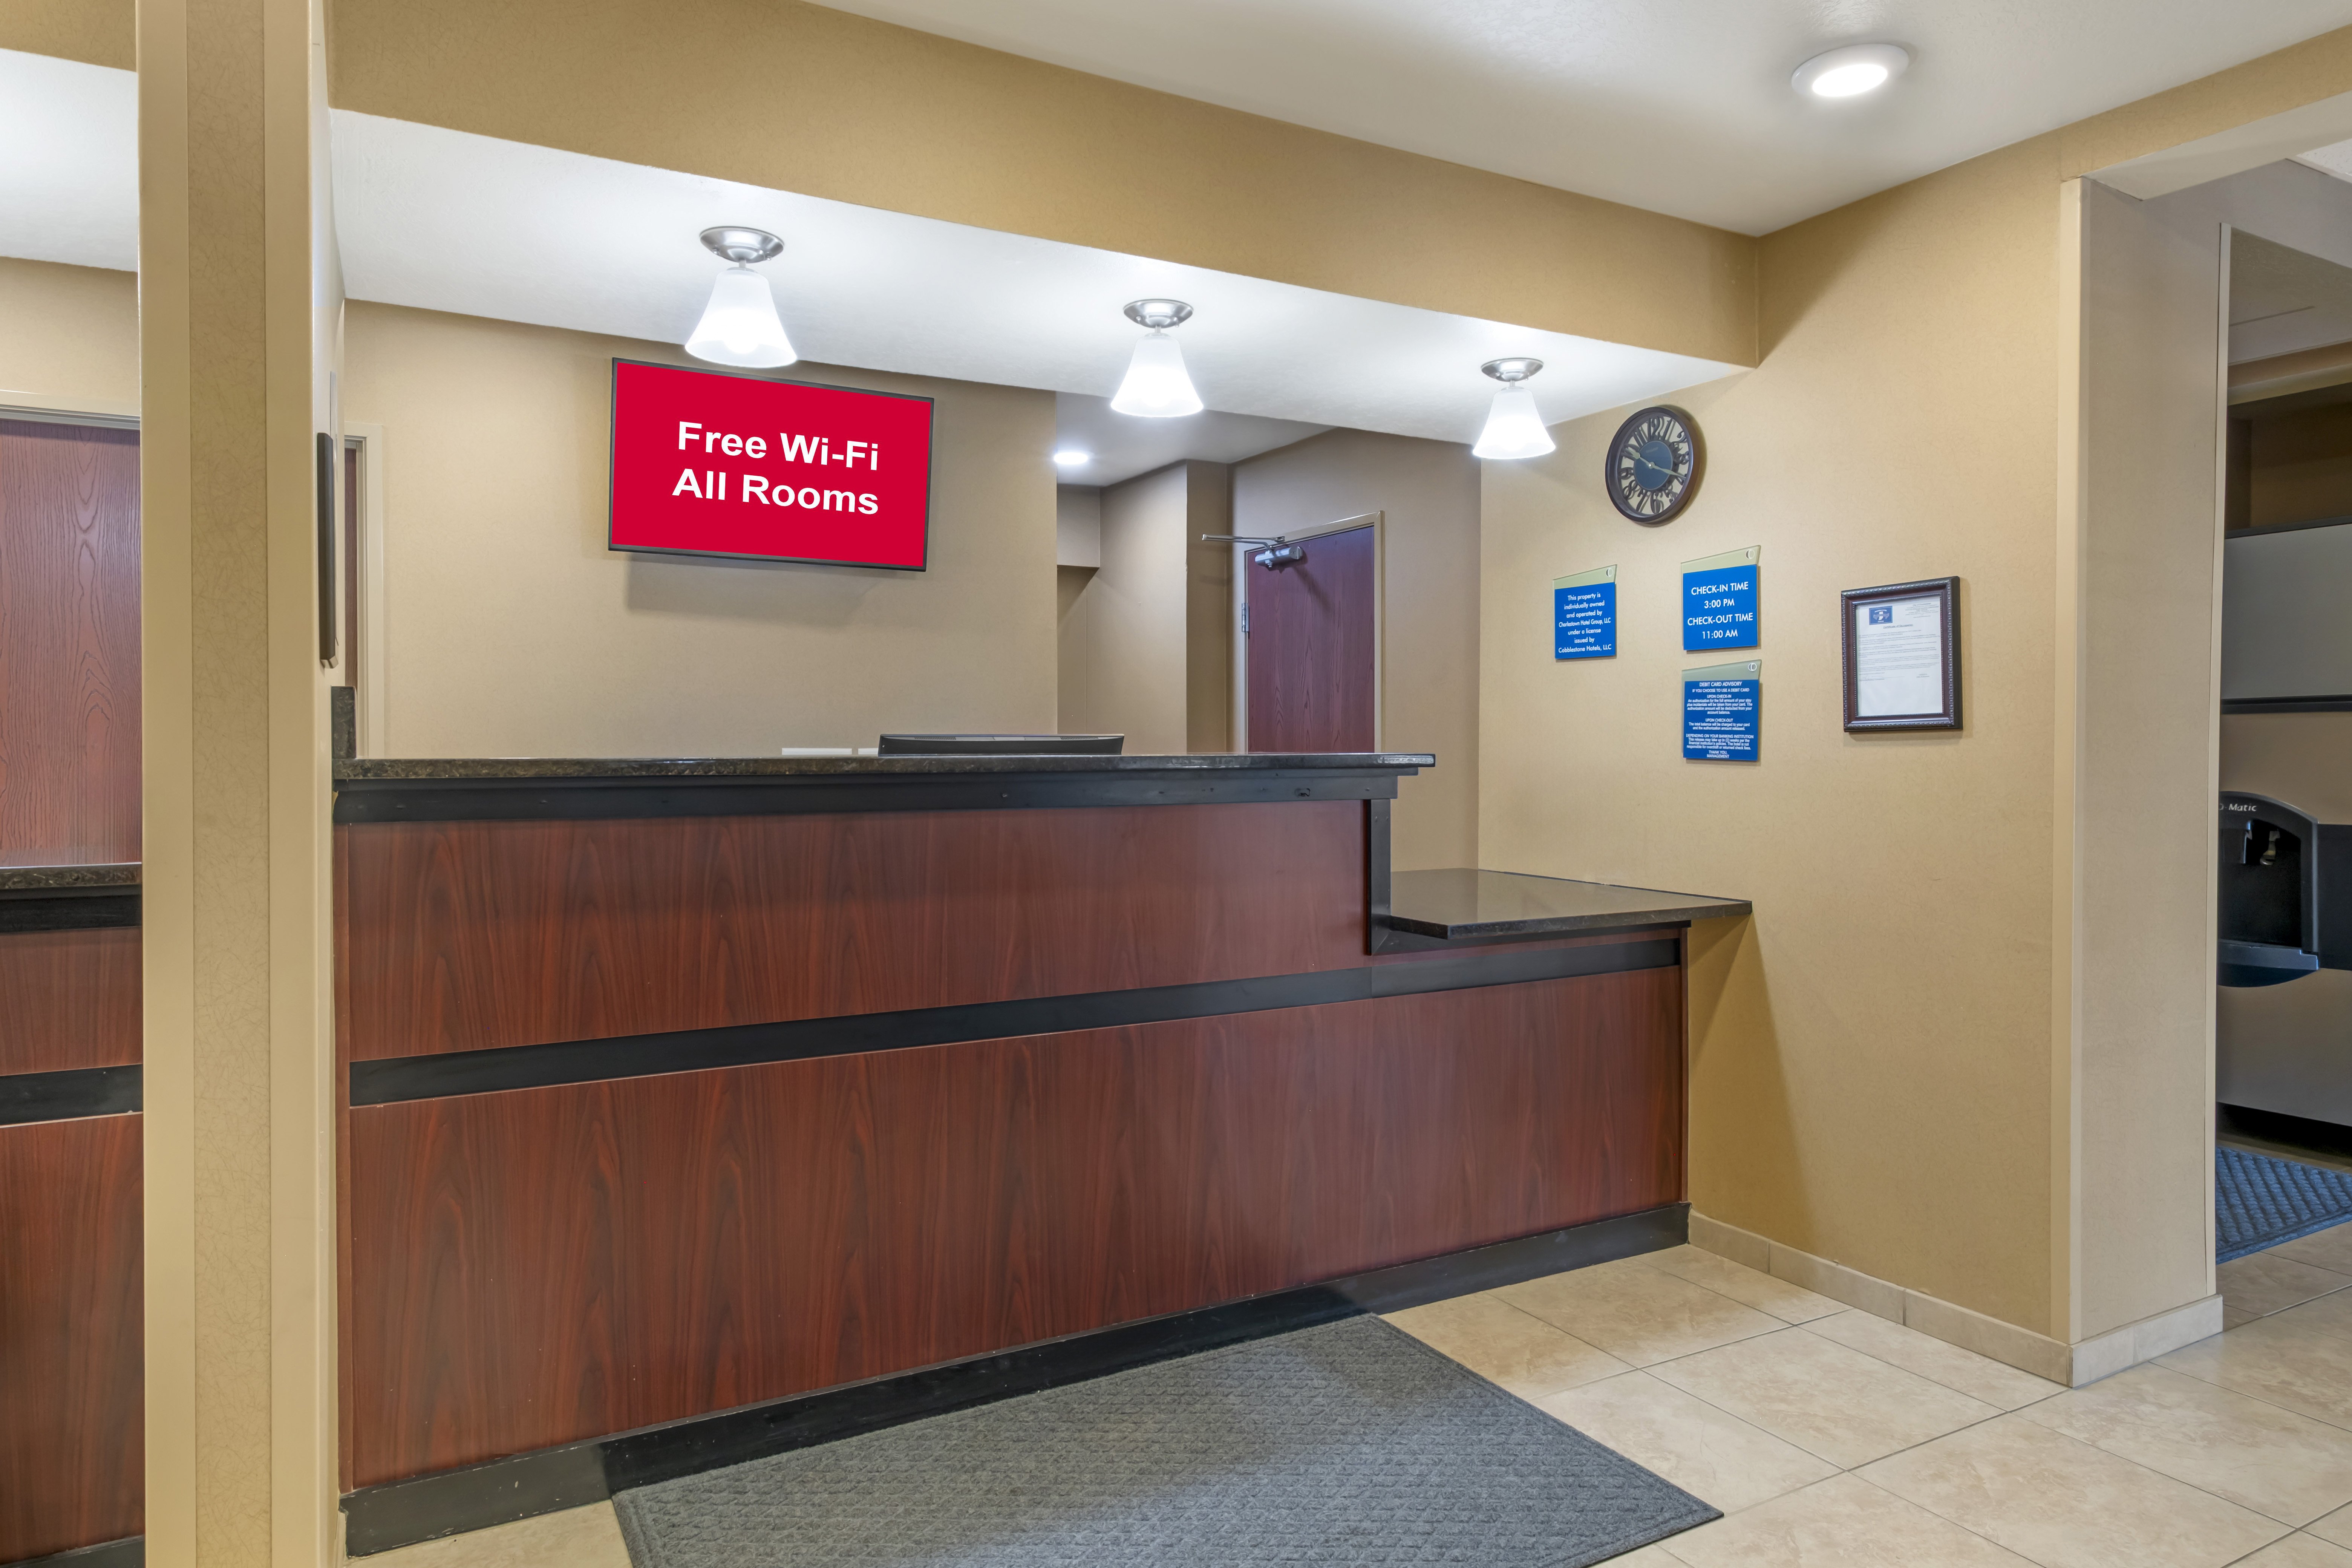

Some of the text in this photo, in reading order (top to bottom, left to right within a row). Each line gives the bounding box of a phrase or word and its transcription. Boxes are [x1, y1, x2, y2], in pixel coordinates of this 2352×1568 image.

[679, 421, 878, 470] Free Wi-Fi
[672, 469, 878, 514] All Rooms
[1691, 582, 1748, 595] CHECK-IN TIME
[1704, 600, 1721, 608] 3:00
[1687, 613, 1753, 625] CHECK-OUT TIME
[1703, 629, 1738, 639] 11:00 AM
